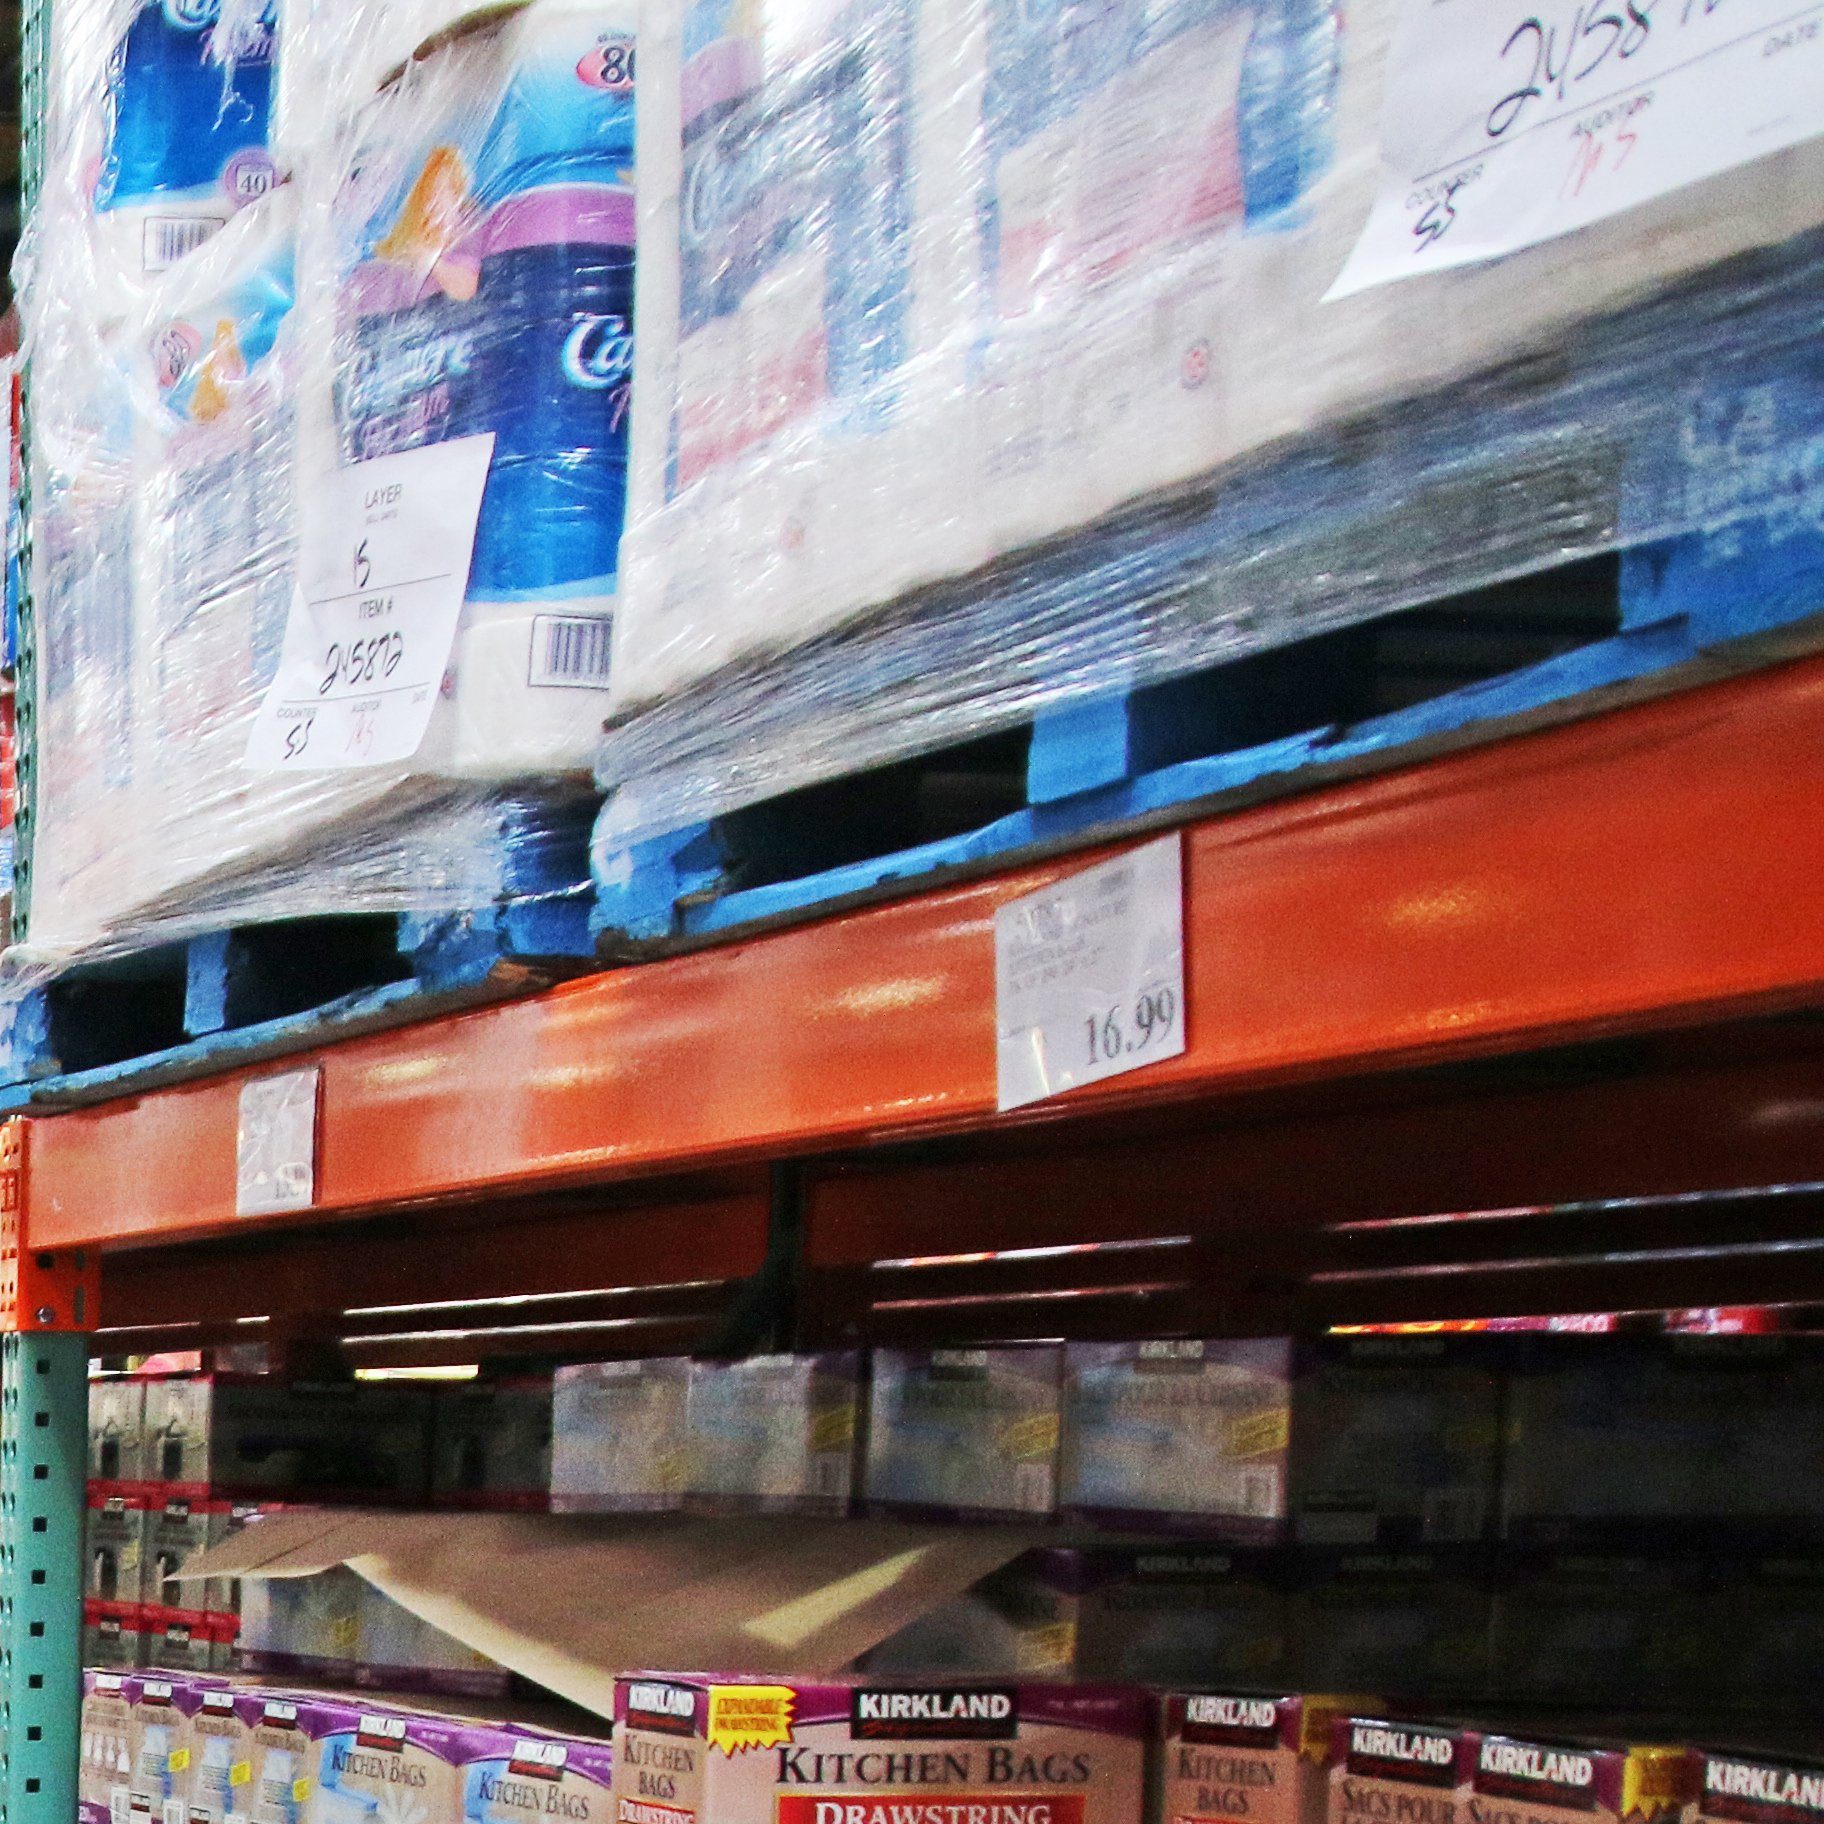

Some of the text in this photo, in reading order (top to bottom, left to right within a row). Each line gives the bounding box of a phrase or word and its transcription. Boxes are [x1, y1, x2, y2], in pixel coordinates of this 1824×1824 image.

[1488, 0, 1720, 137] 2458
[240, 174, 267, 194] 40
[365, 484, 402, 507] LAYER
[359, 603, 384, 619] ITEM
[1085, 987, 1175, 1066] 16.99
[628, 1684, 694, 1717] KIRKLAND
[859, 1694, 1011, 1719] KIRKLAND
[1186, 1699, 1276, 1727] KIRKLAND
[623, 1735, 694, 1773] KITCHEN
[1352, 1729, 1452, 1765] KIRKLAND
[775, 1747, 1090, 1784] KITCHEN BAGS
[1481, 1743, 1592, 1786] KIRKLAND
[1705, 1761, 1824, 1802] KIRKLAN
[638, 1772, 676, 1798] BAGS
